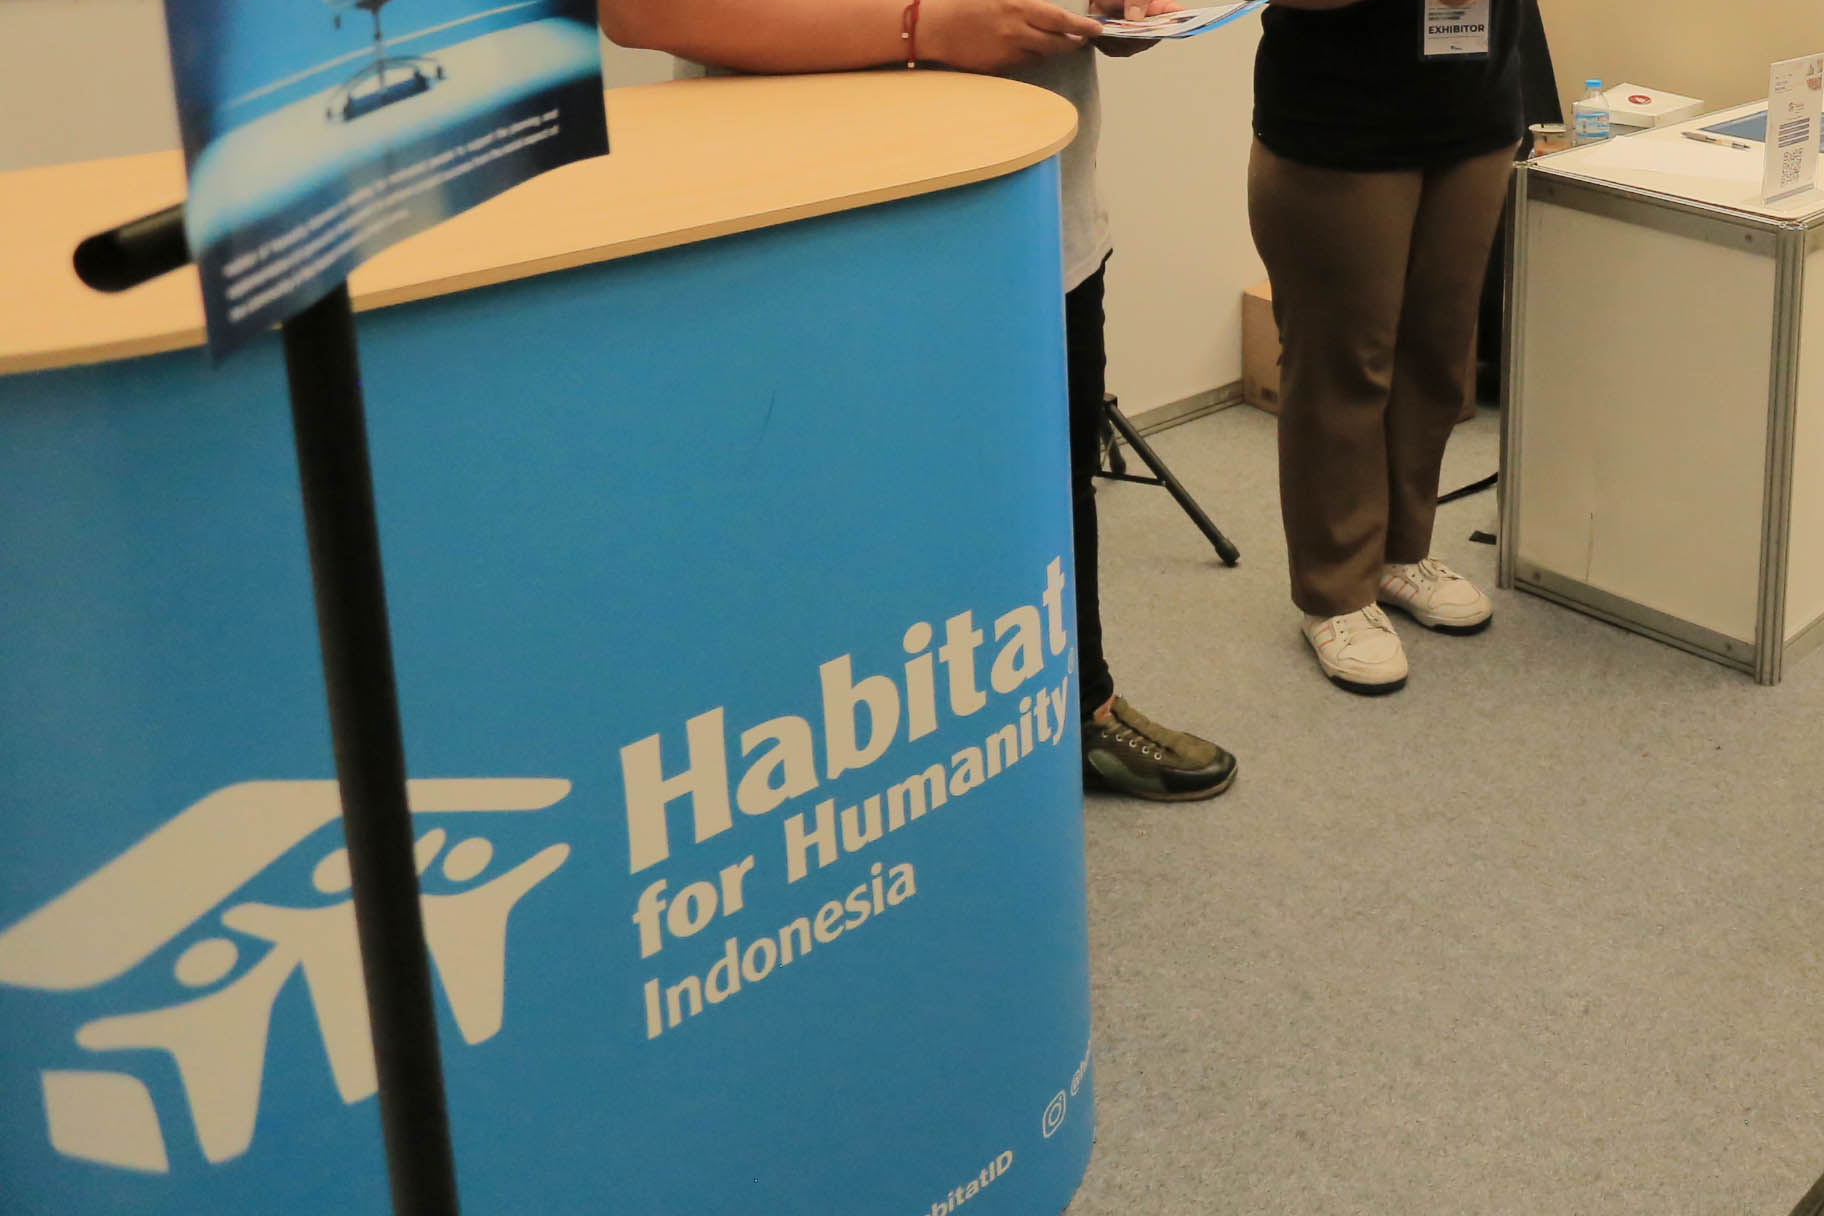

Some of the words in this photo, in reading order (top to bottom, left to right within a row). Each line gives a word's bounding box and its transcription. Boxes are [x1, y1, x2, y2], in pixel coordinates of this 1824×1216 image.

[1428, 24, 1485, 34] EXHIBITOR
[620, 555, 1067, 875] Habitat
[632, 855, 755, 959] for
[784, 676, 1069, 884] Humanity
[643, 861, 917, 1041] Indonesia
[924, 1150, 1014, 1216] bitatID
